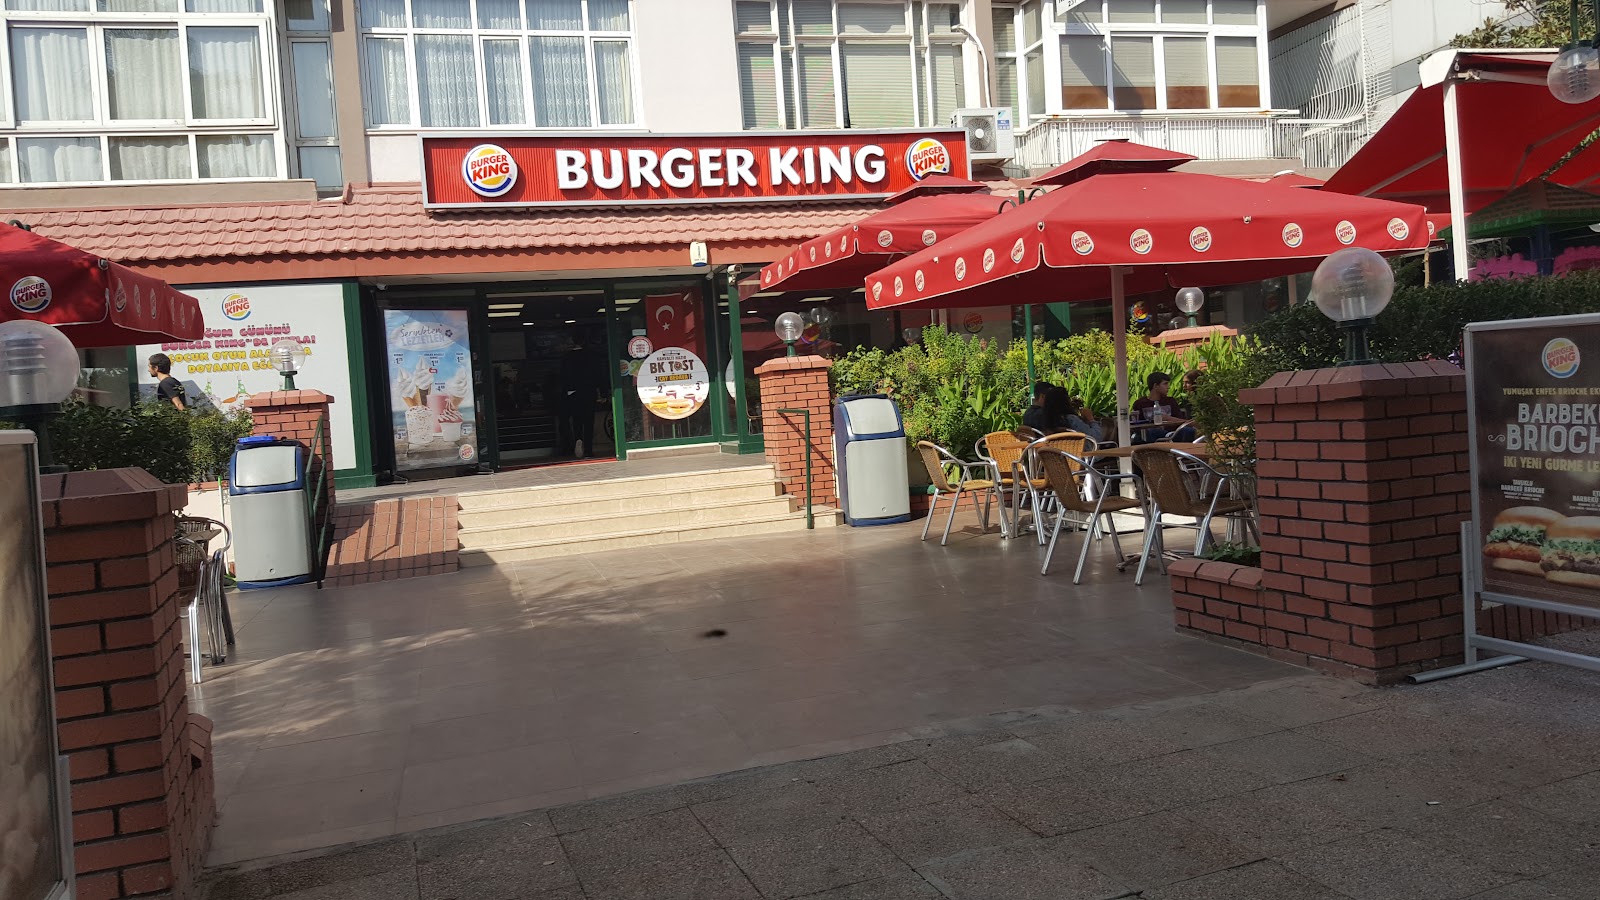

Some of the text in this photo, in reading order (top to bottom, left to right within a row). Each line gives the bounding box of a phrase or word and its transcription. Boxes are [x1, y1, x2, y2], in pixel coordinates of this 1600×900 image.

[912, 146, 943, 163] BURGER
[470, 154, 508, 170] BURGER
[555, 144, 886, 190] BURGER KING
[915, 153, 945, 174] KING
[473, 162, 510, 182] KING
[1193, 231, 1208, 241] BURGER
[1286, 231, 1300, 242] KING
[1340, 228, 1354, 239] KING
[1392, 225, 1406, 235] KING
[1075, 239, 1091, 250] KING
[1133, 233, 1149, 243] BURGER
[1134, 238, 1150, 249] KING
[1193, 236, 1209, 247] KING
[16, 282, 45, 297] BURGER
[17, 289, 47, 305] KING
[224, 297, 249, 309] BURGER
[226, 302, 250, 316] KING
[204, 323, 291, 339] ĞUM GÜNÜNÜ
[161, 339, 211, 351] BURGER
[212, 349, 247, 361] OYUN
[1546, 345, 1574, 360] BURGER
[1548, 352, 1576, 368] KING
[188, 361, 250, 374] DOYASIYA
[650, 362, 665, 374] BK
[1503, 387, 1600, 397] YUMUŞAK ENFES BRIOCHE EK
[1518, 402, 1600, 425] BARBEK
[1544, 458, 1584, 472] GURME
